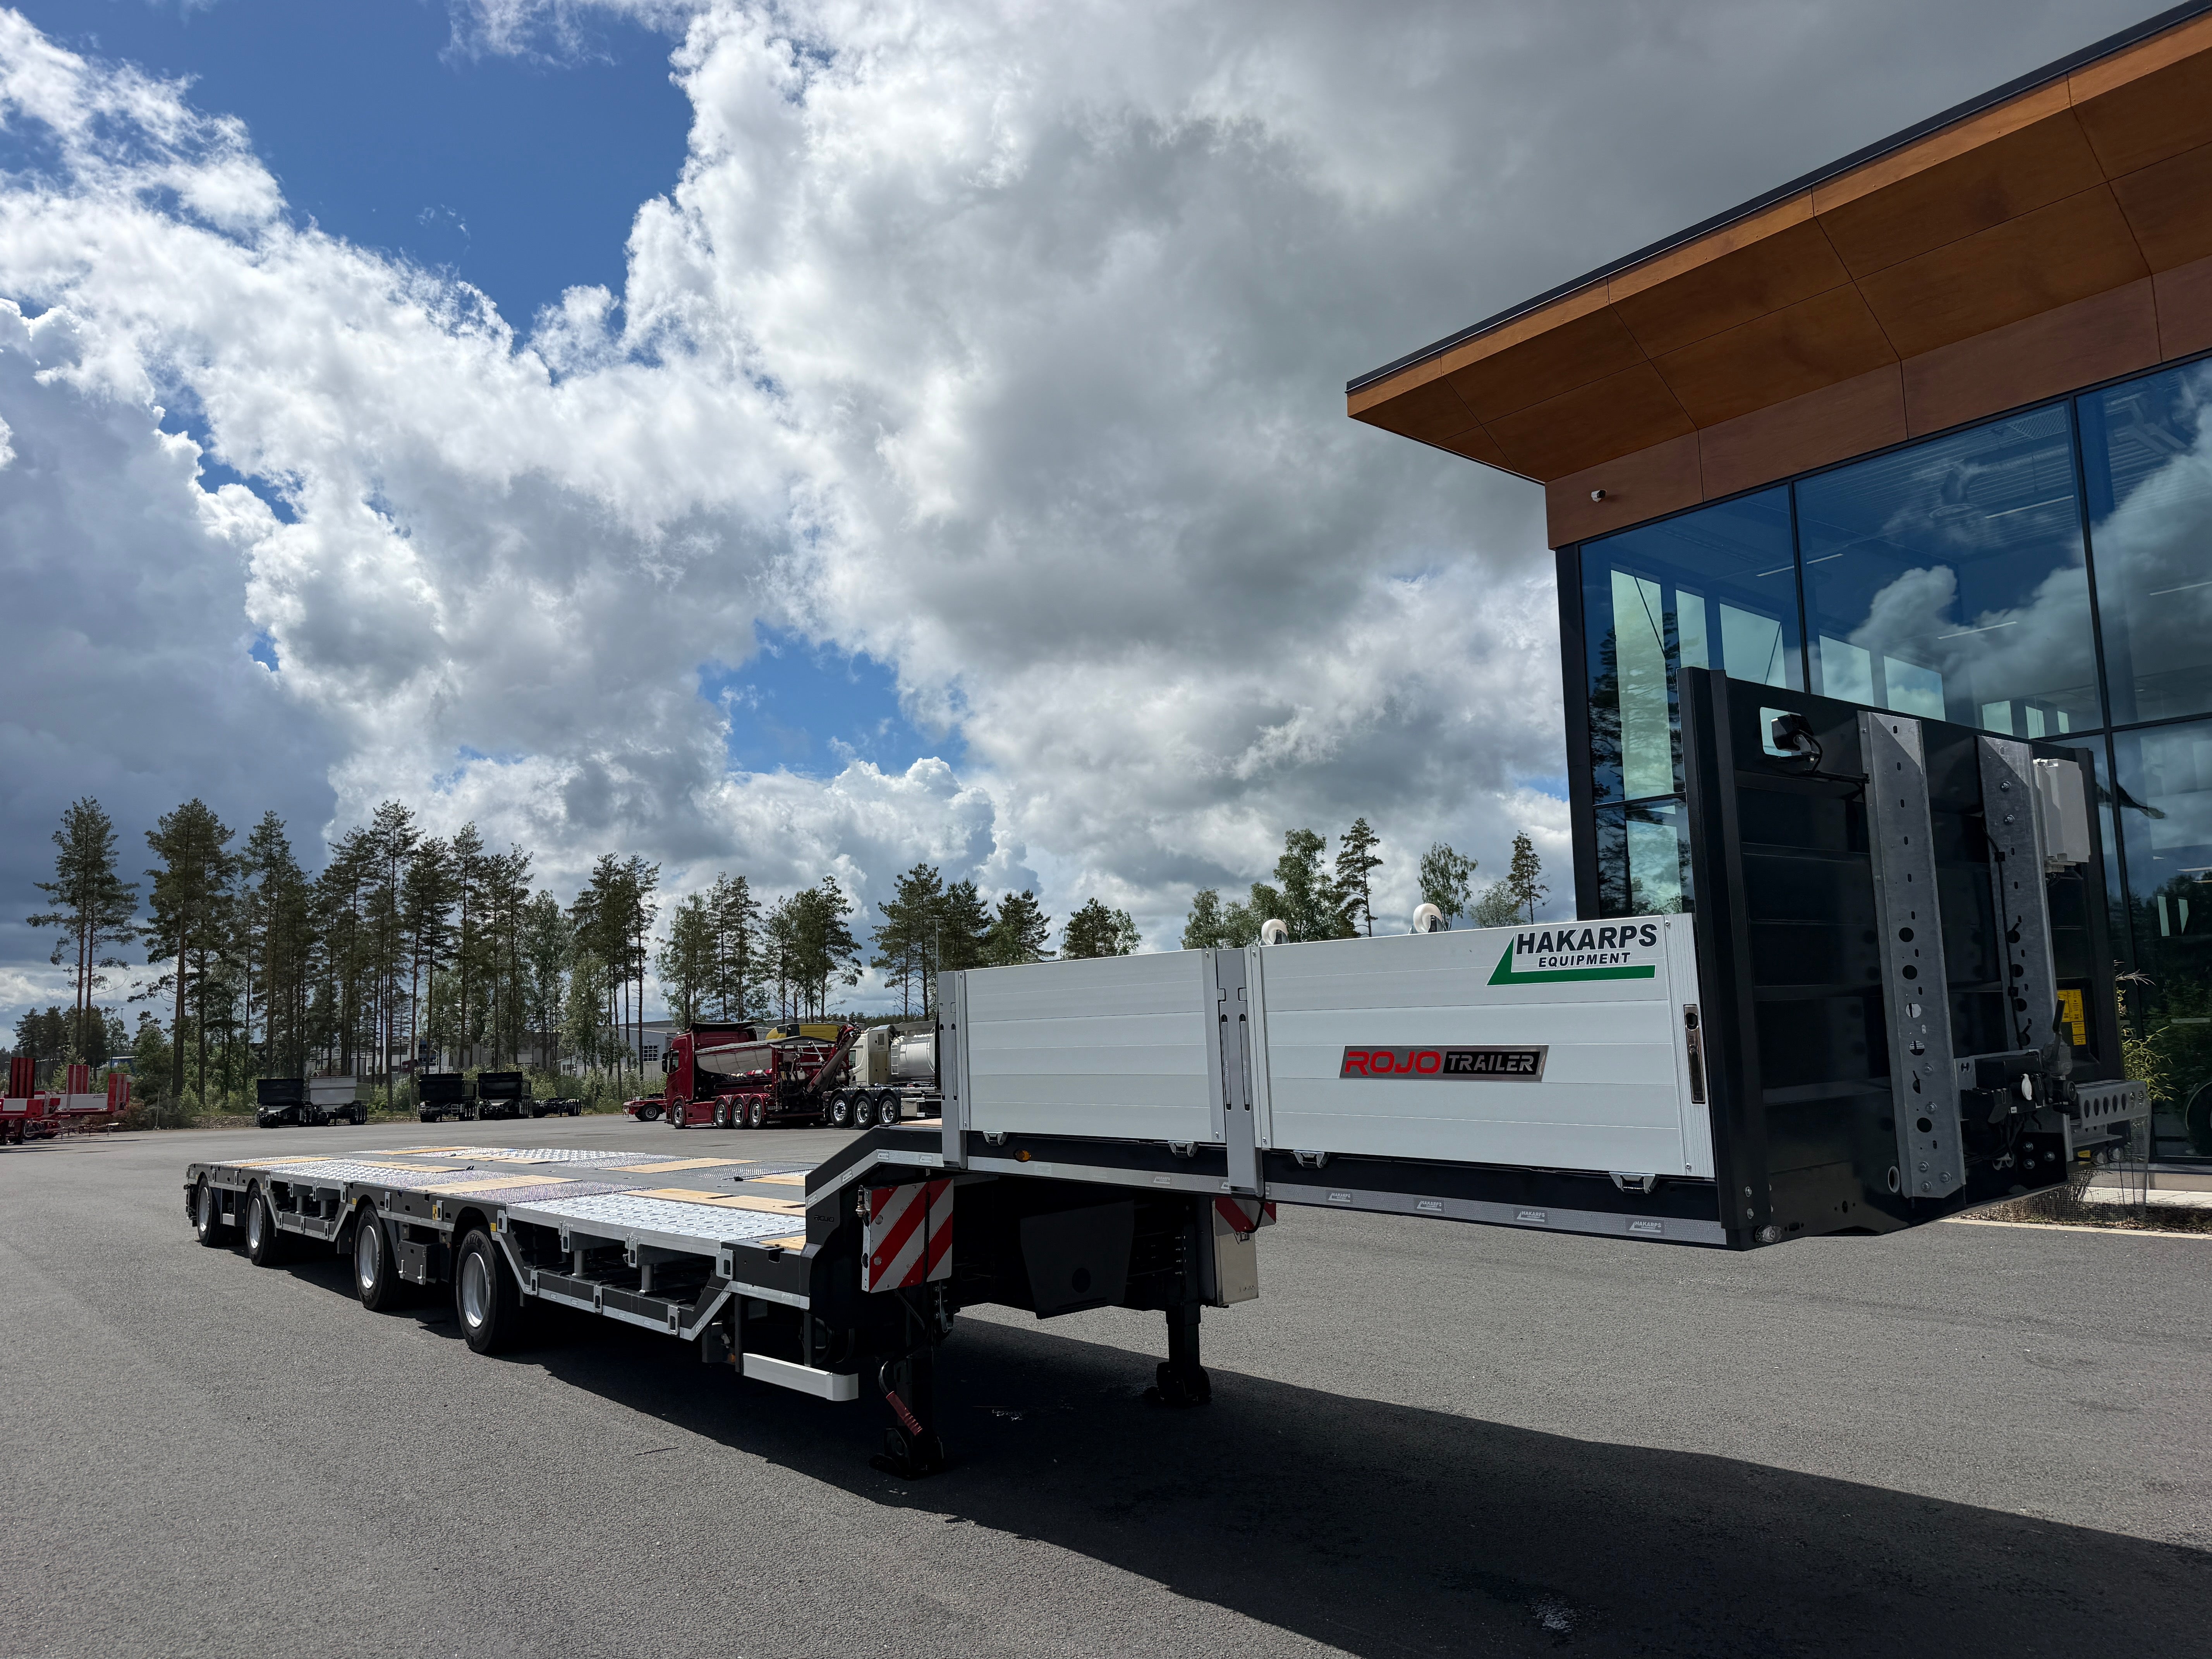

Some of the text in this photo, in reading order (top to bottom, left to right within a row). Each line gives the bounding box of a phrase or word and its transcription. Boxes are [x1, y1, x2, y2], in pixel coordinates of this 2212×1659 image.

[1516, 924, 1657, 955] HAKARPS
[1539, 952, 1631, 967] EQUIPMENT
[1345, 1051, 1534, 1076] ROJO TRAILER
